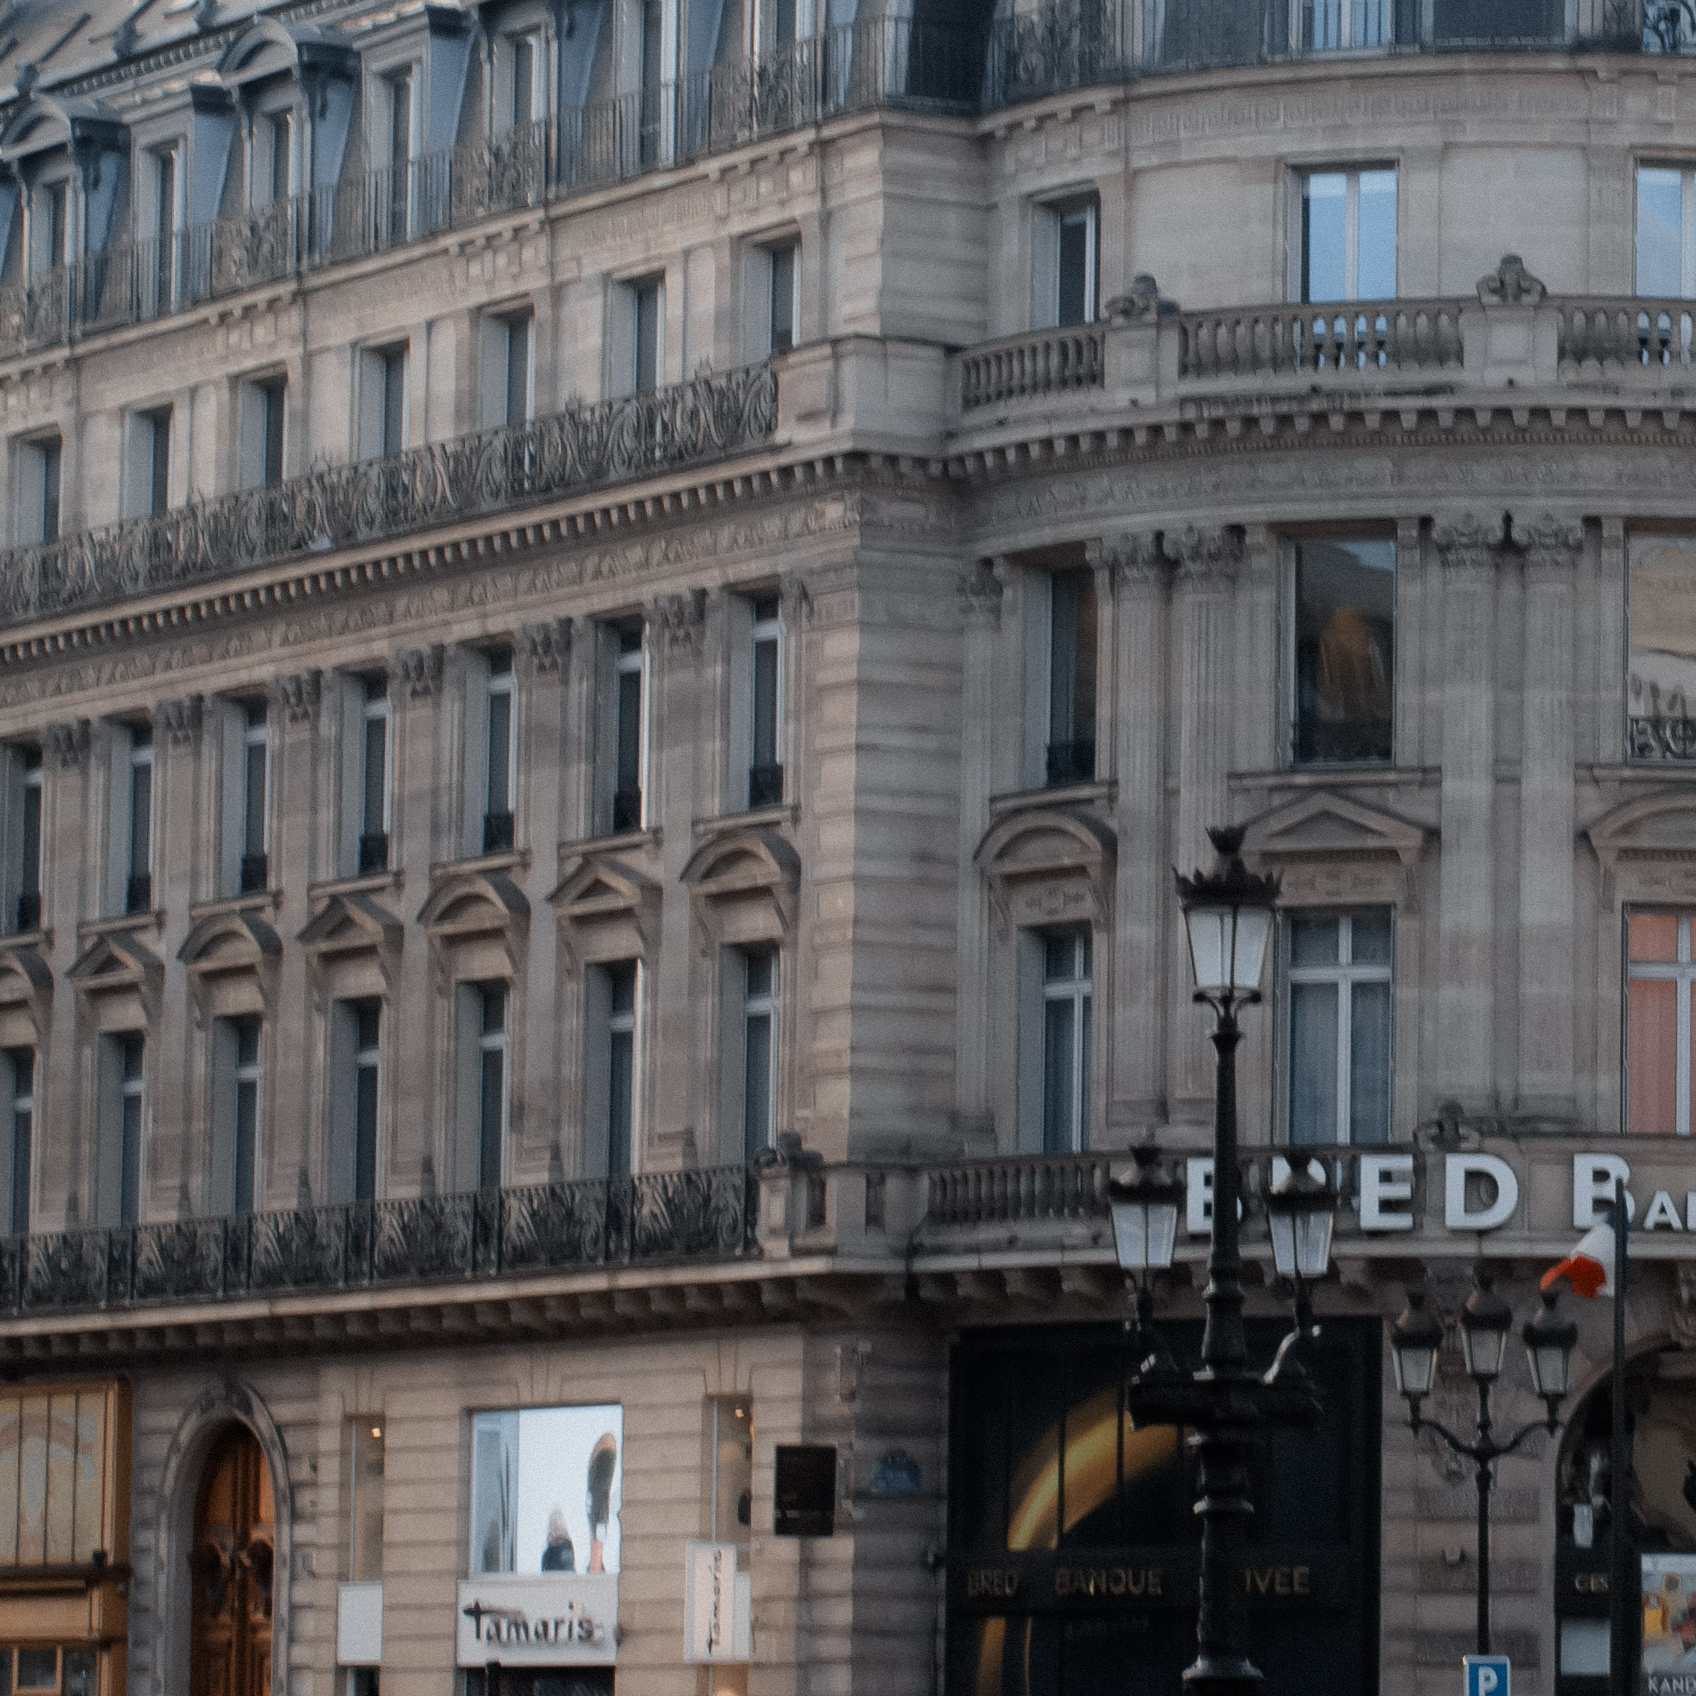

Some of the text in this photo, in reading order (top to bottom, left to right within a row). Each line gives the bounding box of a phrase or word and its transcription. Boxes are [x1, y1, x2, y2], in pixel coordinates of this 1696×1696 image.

[967, 1565, 1311, 1597] BRED BANQUE IVEE
